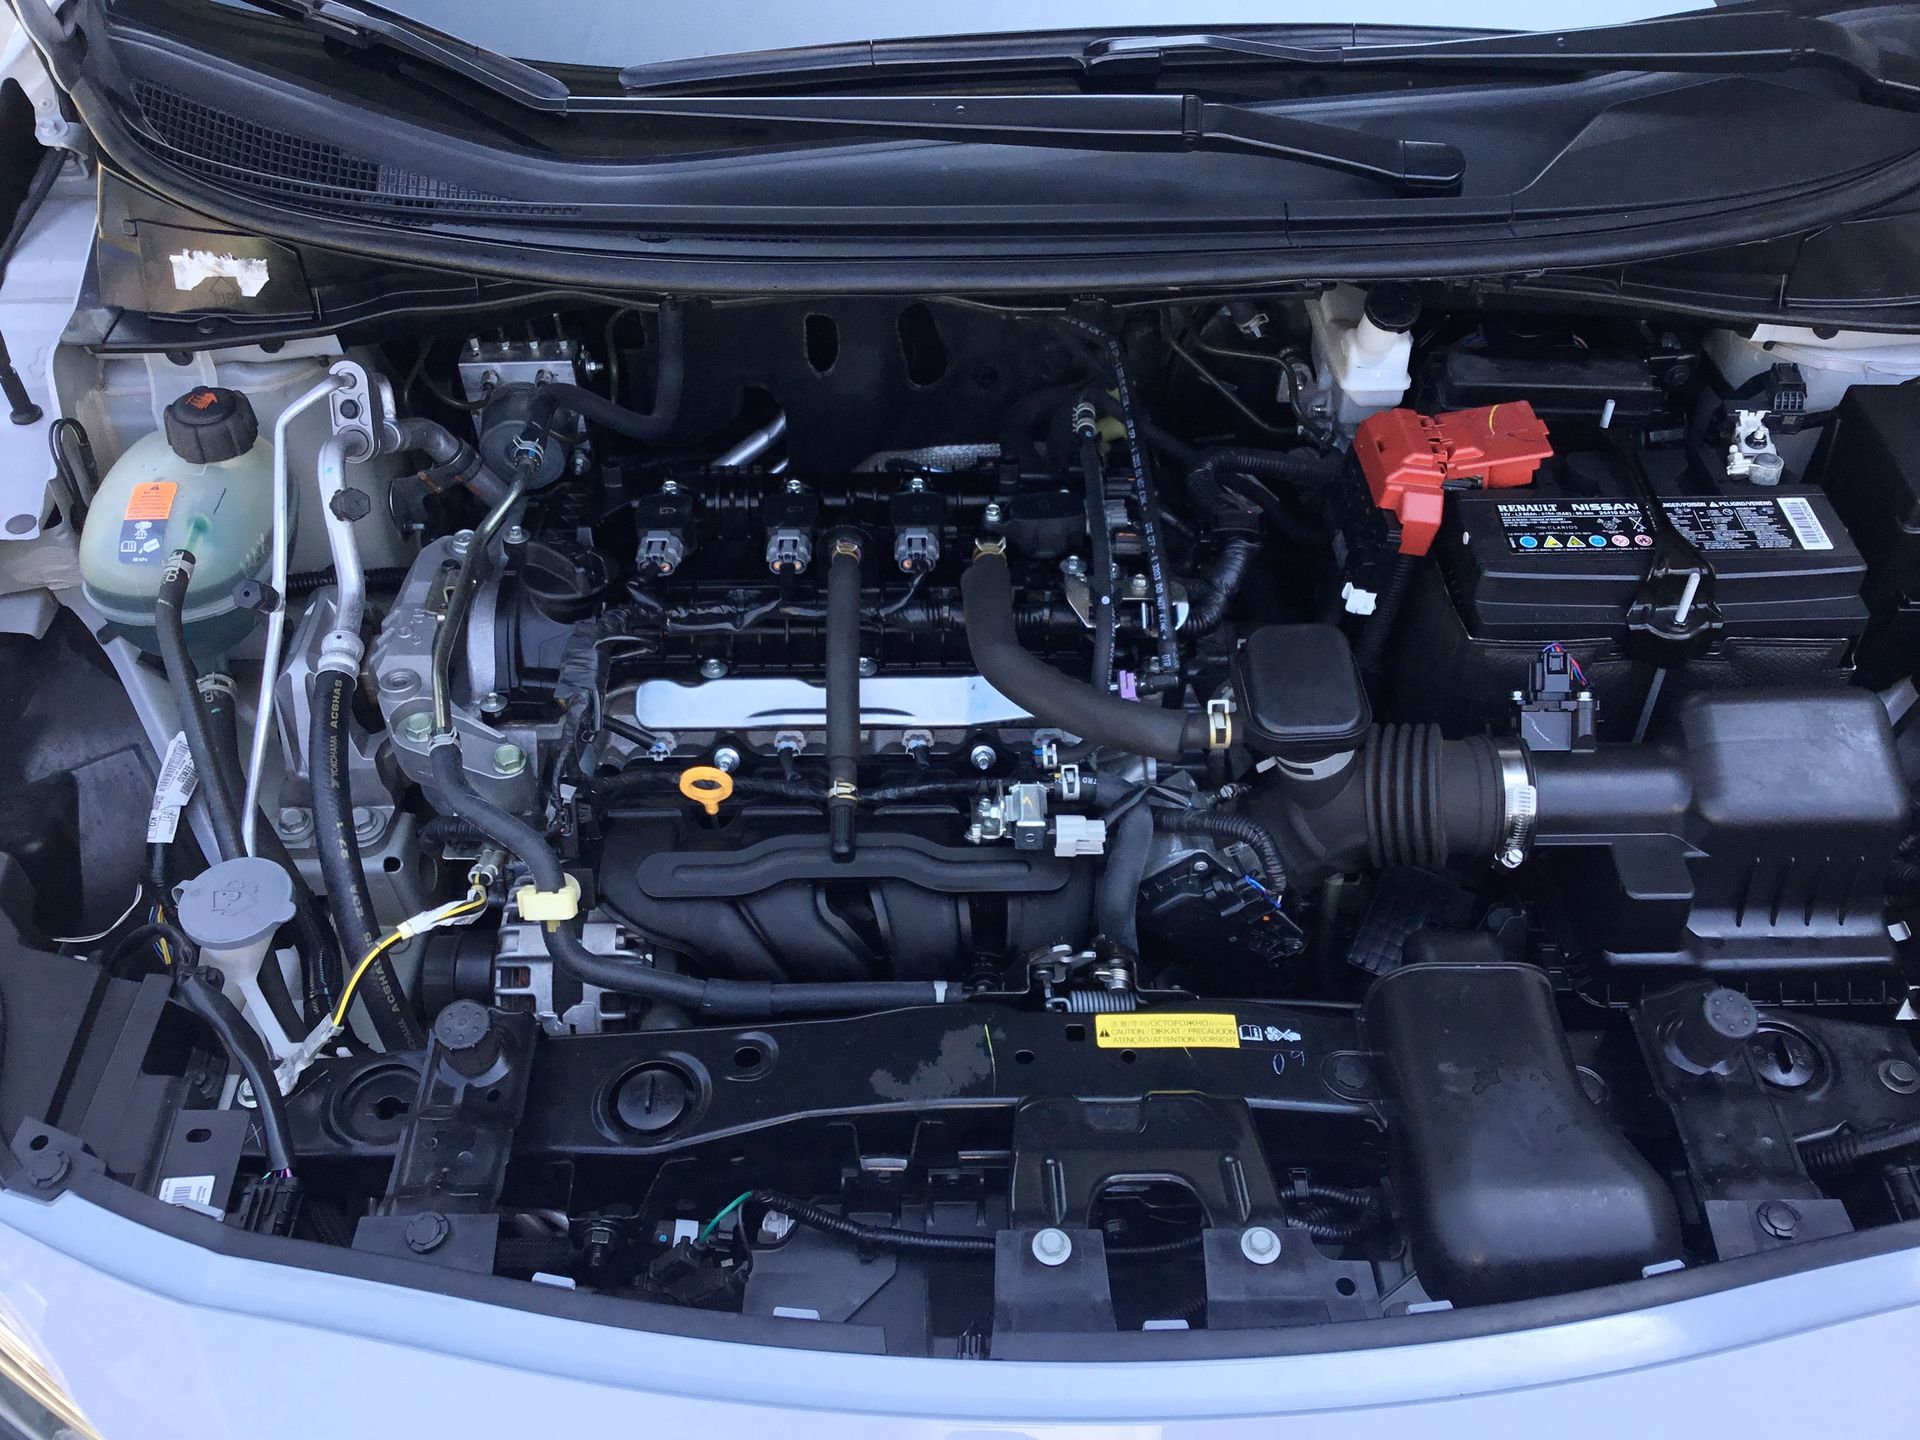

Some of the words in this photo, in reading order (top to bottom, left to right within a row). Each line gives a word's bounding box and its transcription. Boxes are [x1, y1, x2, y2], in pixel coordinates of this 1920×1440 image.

[1497, 503, 1558, 512] RENAULT
[1571, 503, 1639, 511] NISSAN
[328, 735, 340, 779] YOKOHAMA
[1111, 1028, 1145, 1036] CAUTION
